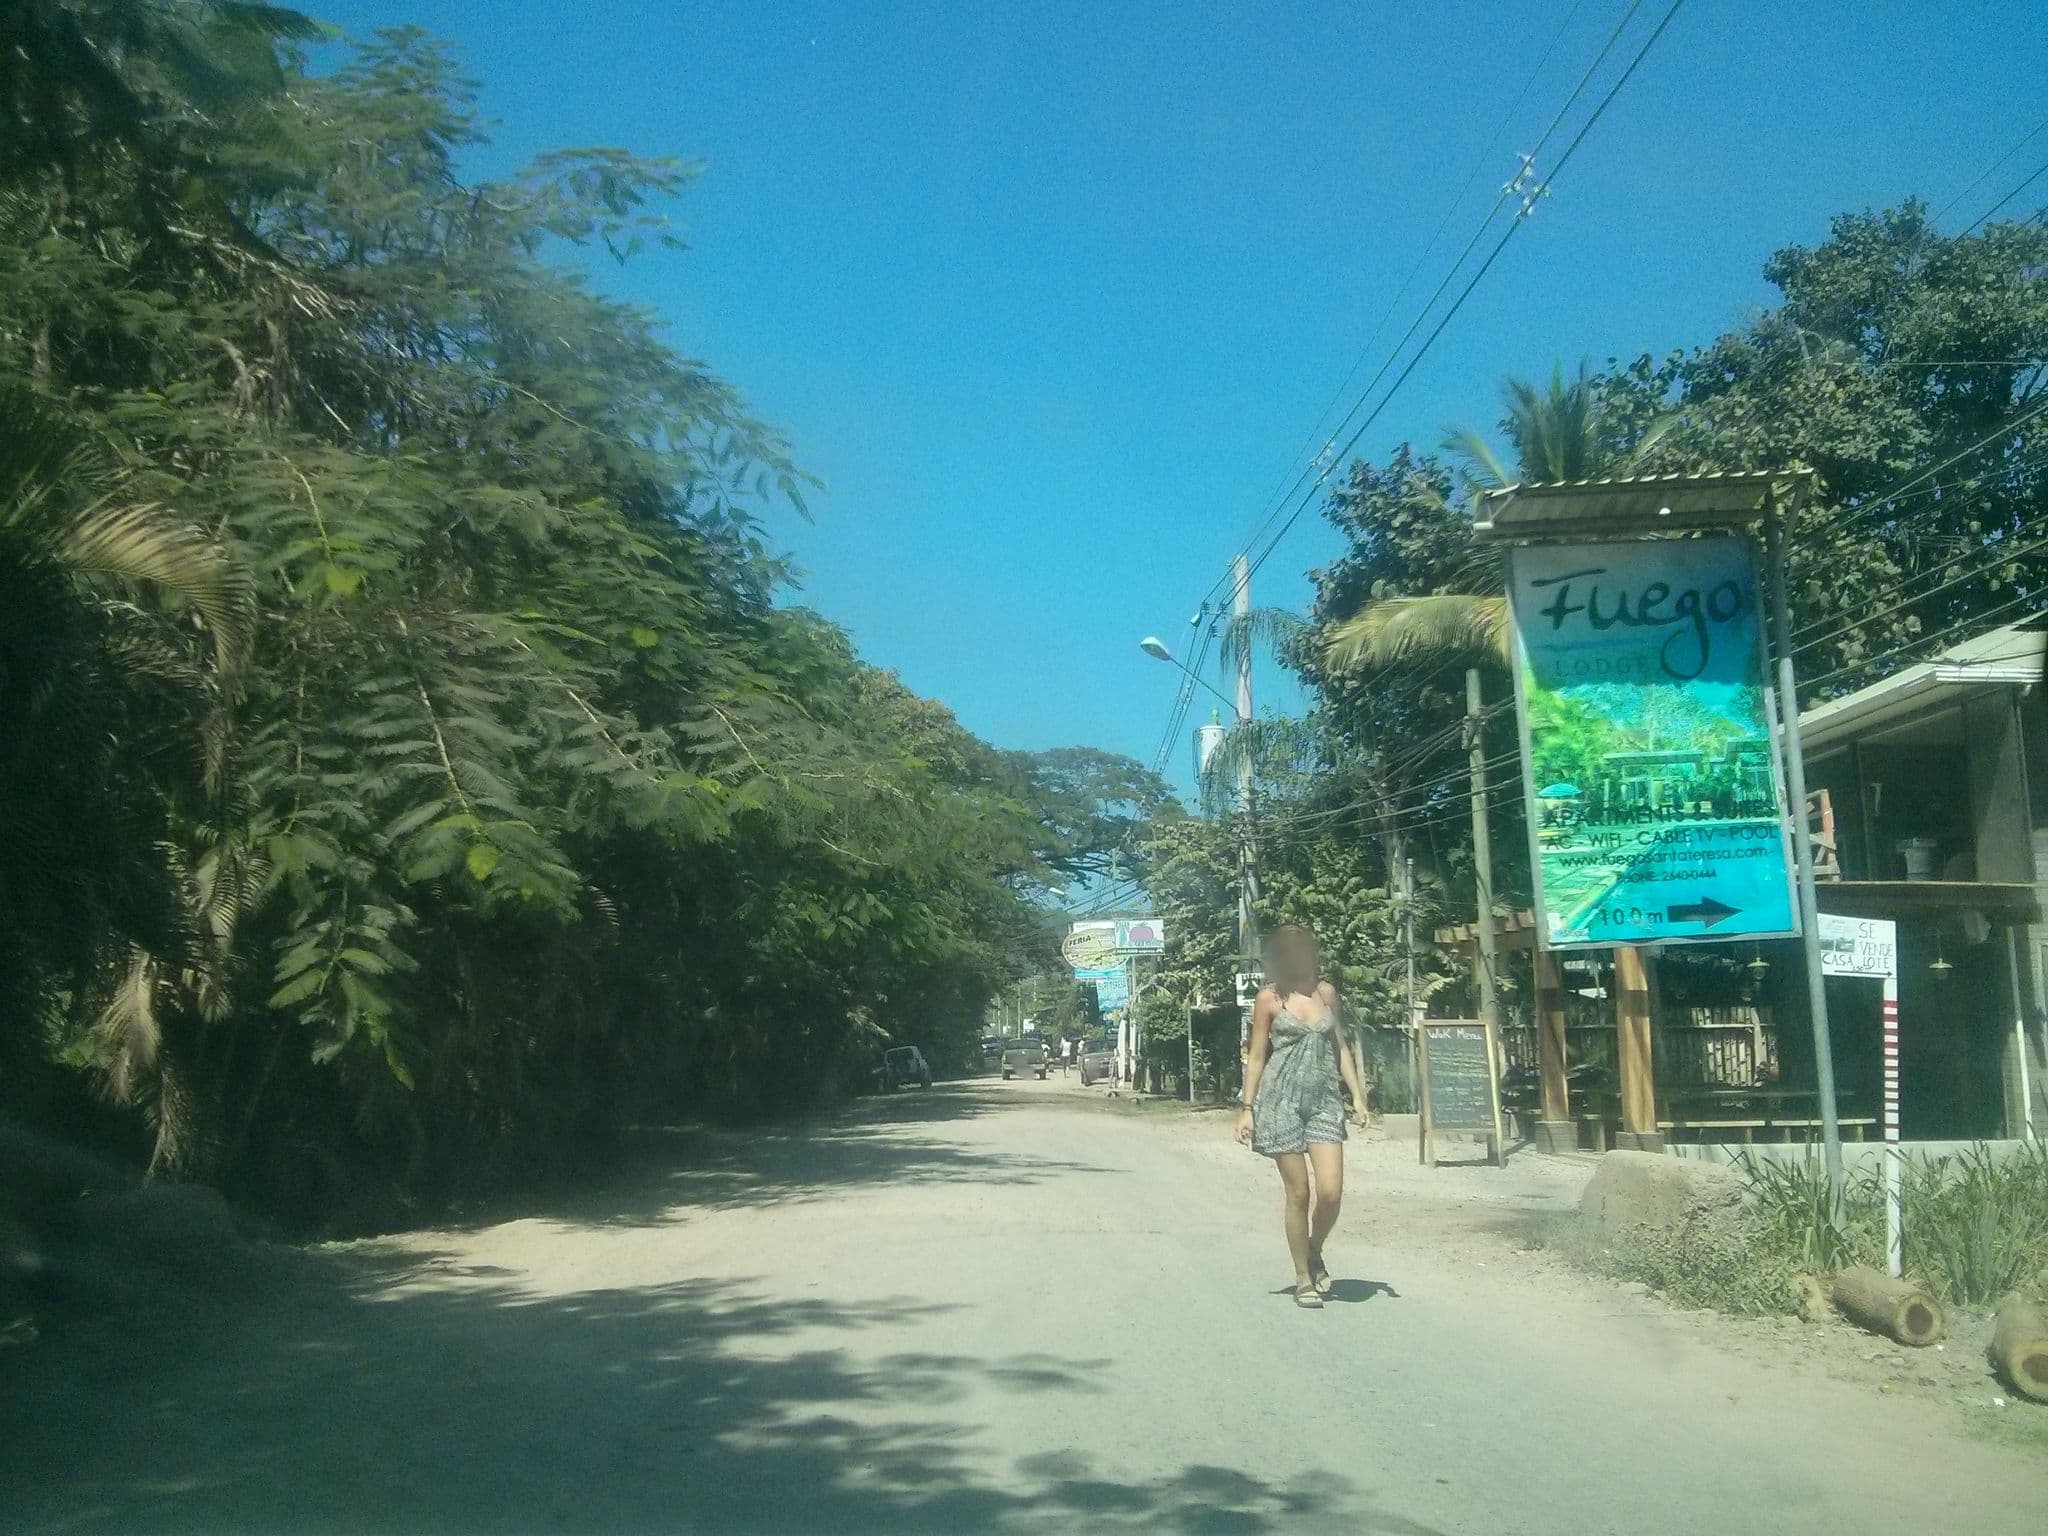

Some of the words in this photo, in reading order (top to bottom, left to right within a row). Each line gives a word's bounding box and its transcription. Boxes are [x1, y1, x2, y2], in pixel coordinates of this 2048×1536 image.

[1531, 568, 1743, 679] Fuego
[1555, 658, 1650, 677] LODGE
[1544, 803, 1686, 828] APARTMENTS
[1546, 835, 1573, 850] AC
[1588, 832, 1621, 848] WIFI
[1638, 827, 1692, 846] CABLE
[1695, 828, 1714, 842] TV
[1730, 825, 1777, 841] POOL
[1560, 847, 1768, 868] www.fuegosantateresa.com
[1662, 868, 1717, 881] 2640-0444
[1858, 922, 1876, 939] SE
[1068, 935, 1092, 947] FERIA
[1859, 941, 1894, 957] VENDE
[1821, 953, 1854, 966] CASA
[1863, 957, 1890, 969] LOTE
[1456, 1028, 1482, 1040] Menu
